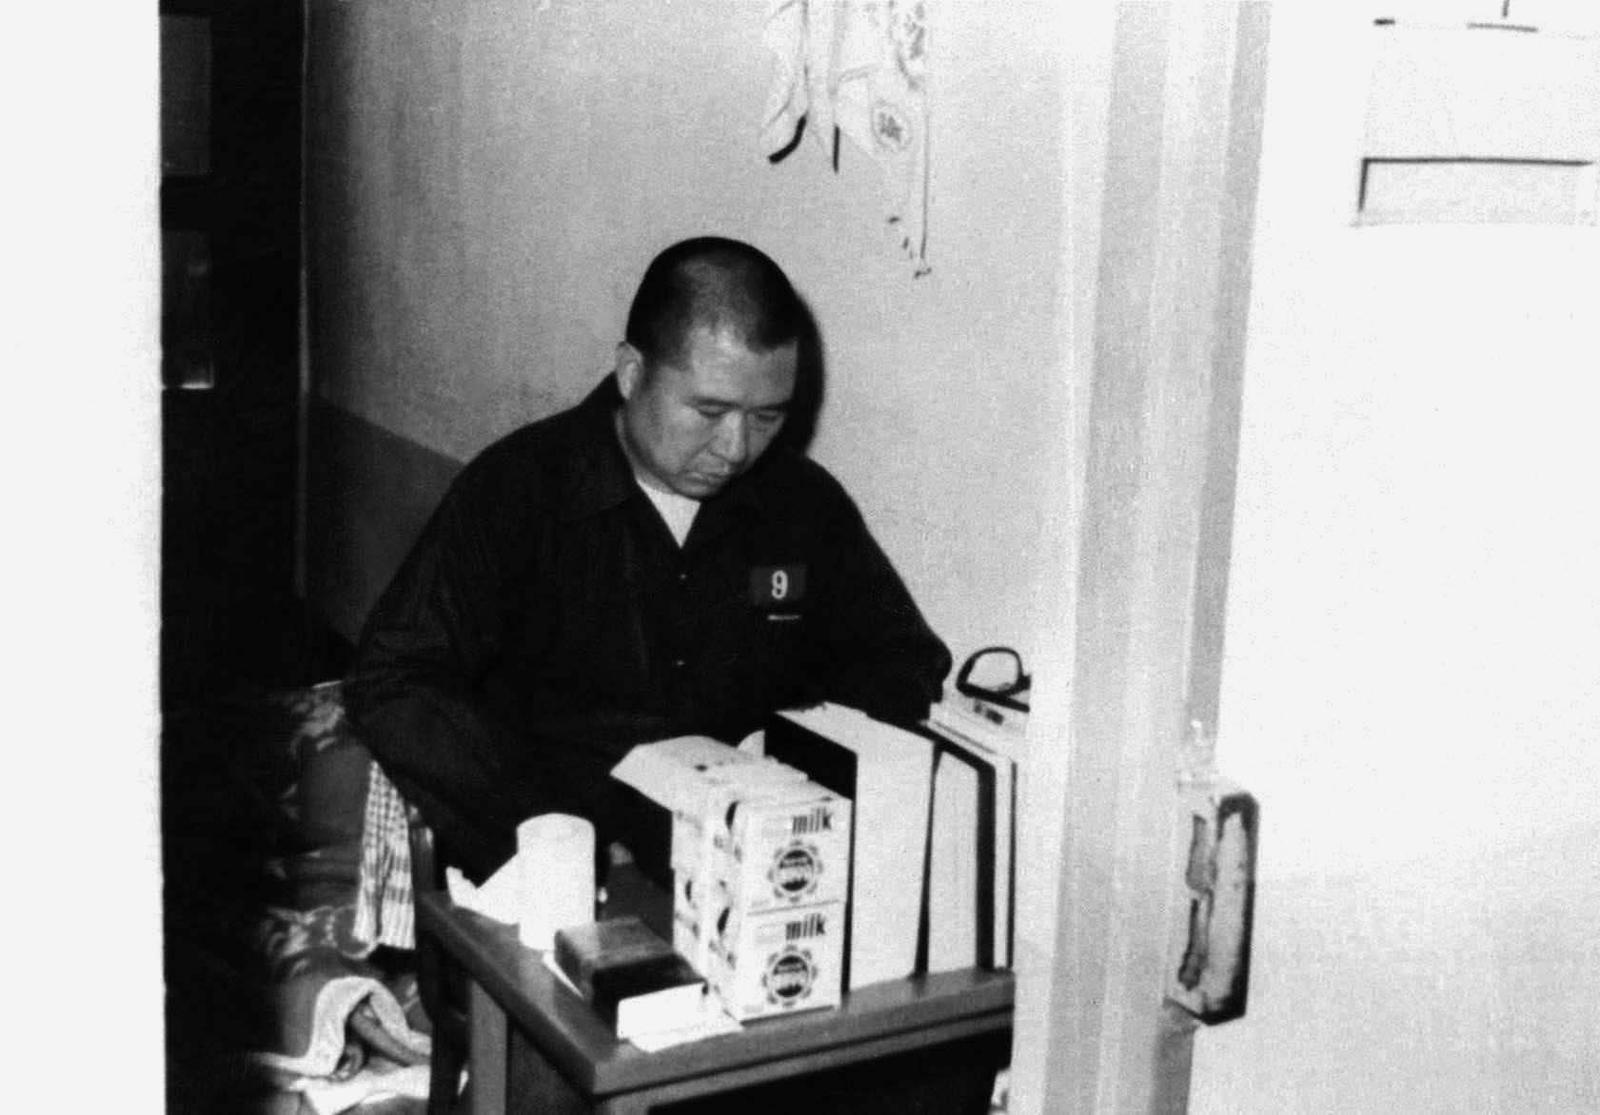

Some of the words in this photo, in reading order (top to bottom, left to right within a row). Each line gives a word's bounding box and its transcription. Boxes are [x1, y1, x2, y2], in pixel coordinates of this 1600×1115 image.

[772, 570, 788, 599] 9
[793, 807, 832, 834] milk
[786, 913, 825, 940] milk
